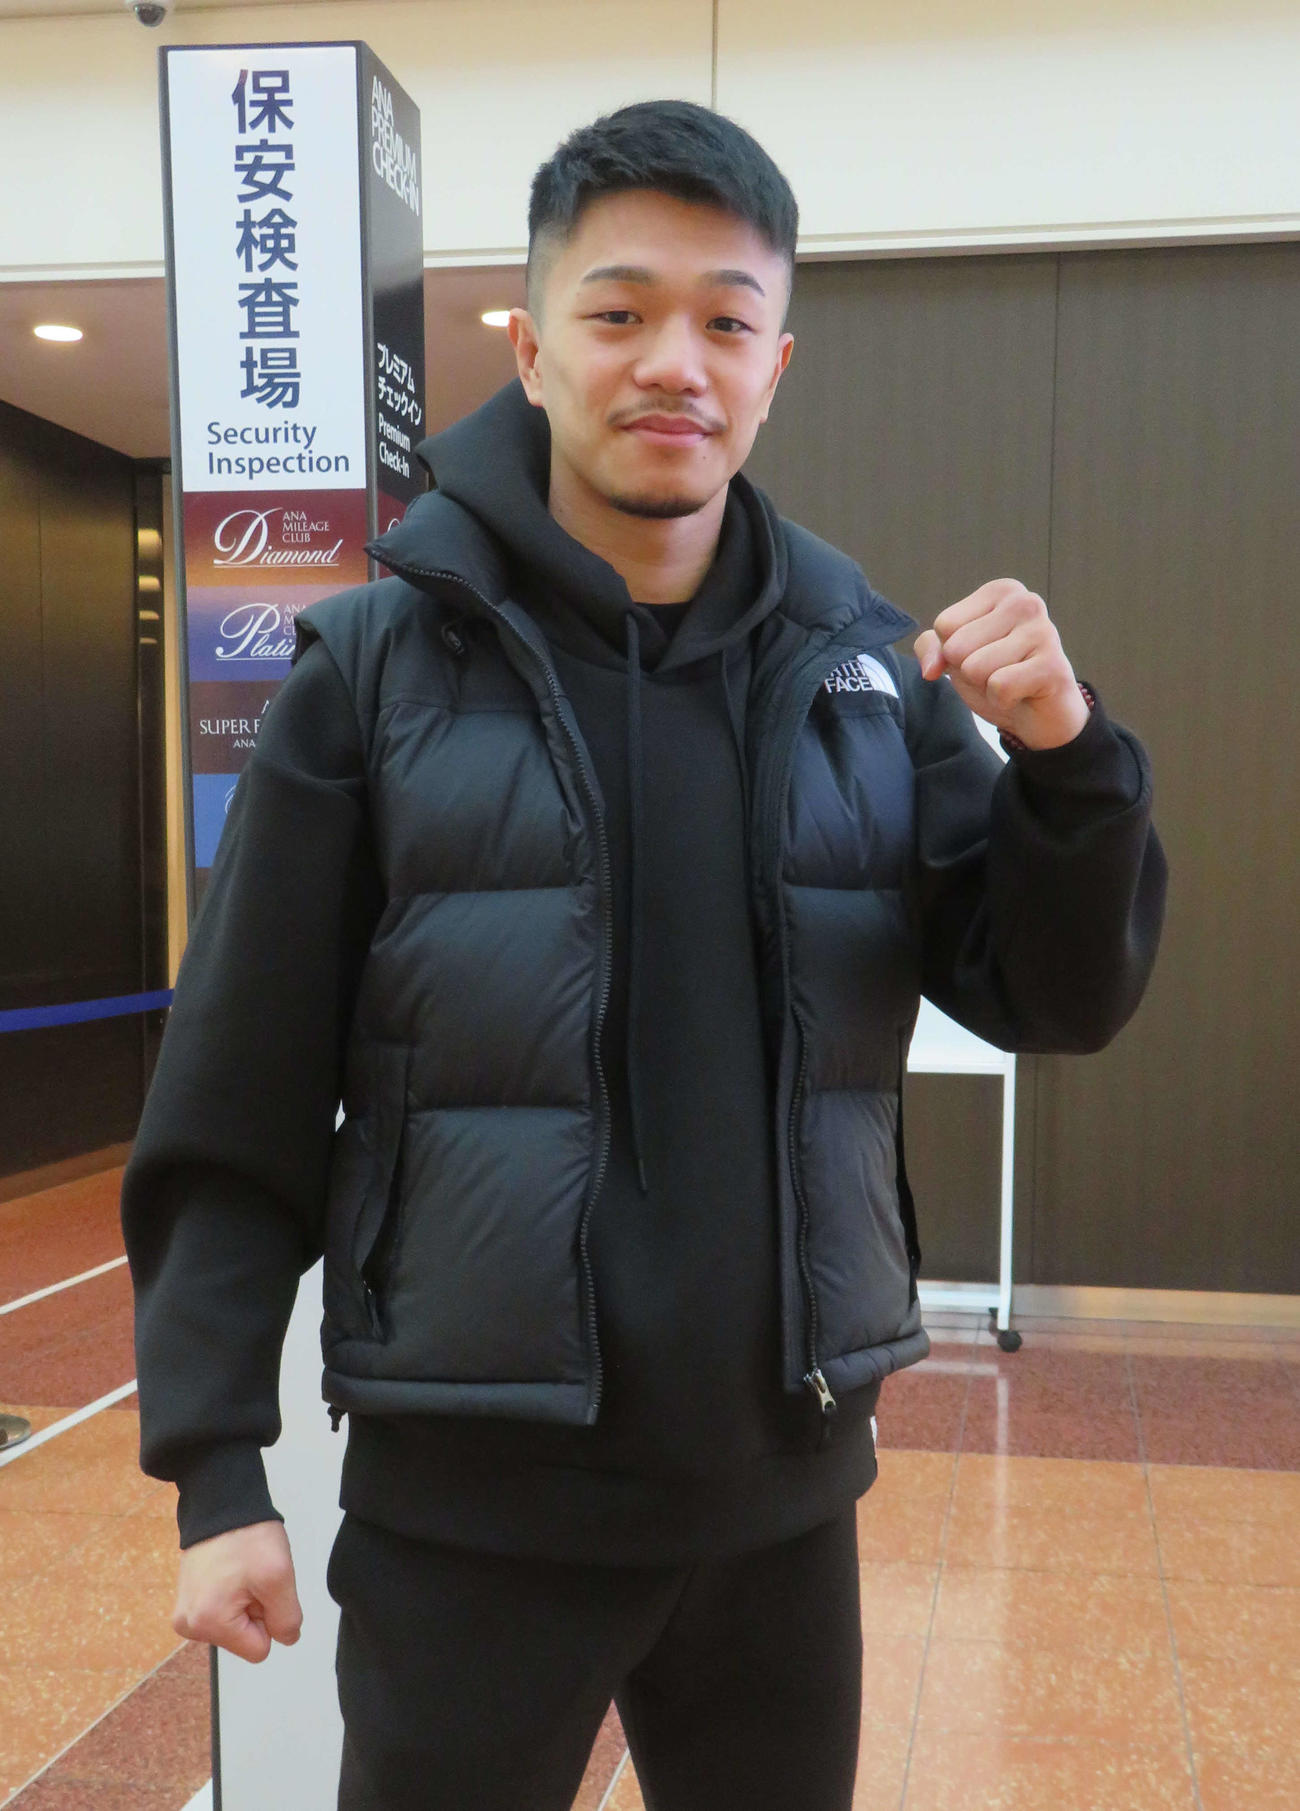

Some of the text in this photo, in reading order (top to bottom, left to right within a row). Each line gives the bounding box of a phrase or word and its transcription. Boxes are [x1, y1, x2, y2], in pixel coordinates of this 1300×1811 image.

[371, 75, 395, 126] ANA
[371, 105, 417, 183] PREMIUM
[372, 141, 419, 216] CHECK-IN
[230, 68, 301, 410] 保安検査場
[376, 342, 416, 394] プレミアム
[377, 376, 422, 426] チェックイン
[206, 421, 318, 449] Security
[378, 412, 411, 452] Premium
[208, 450, 350, 480] Inspection
[379, 443, 410, 479] Check-In
[282, 511, 307, 521] ANA
[282, 521, 330, 532] MILEAGE
[213, 507, 343, 565] Diamond
[282, 532, 311, 543] CLUB
[215, 603, 296, 658] Plati
[824, 677, 874, 694] FACE
[199, 719, 251, 735] SUPER
[232, 739, 256, 748] ANA
